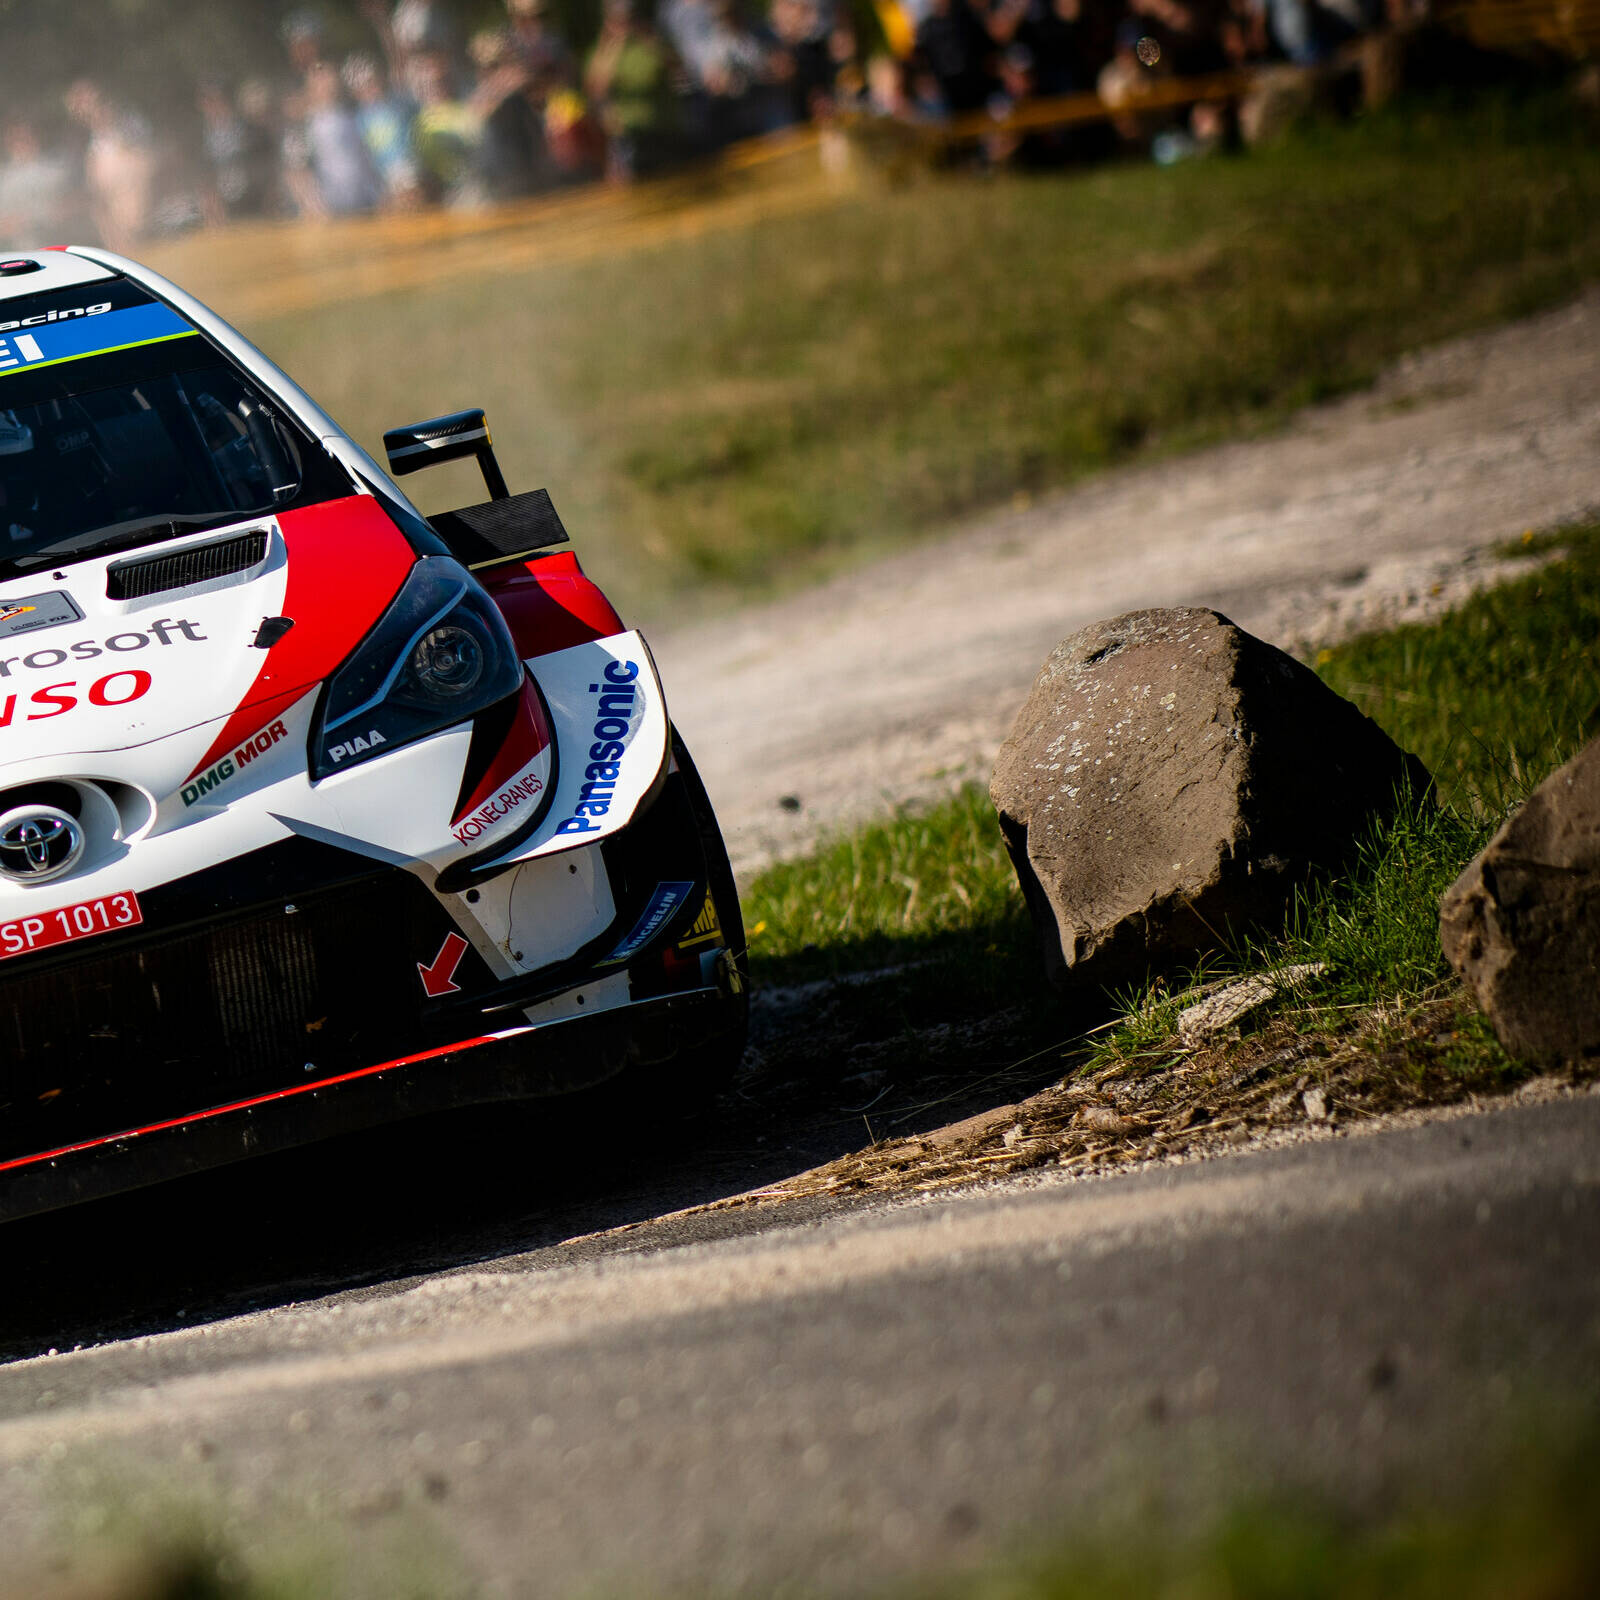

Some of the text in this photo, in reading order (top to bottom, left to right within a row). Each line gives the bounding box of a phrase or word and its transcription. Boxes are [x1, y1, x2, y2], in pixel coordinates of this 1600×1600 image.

[328, 729, 387, 763] PIAA
[555, 660, 639, 836] Panasonic
[180, 758, 235, 808] DMG
[452, 773, 543, 847] KONECRANES
[0, 895, 133, 952] SP 1013
[626, 892, 677, 949] MICHELIN
